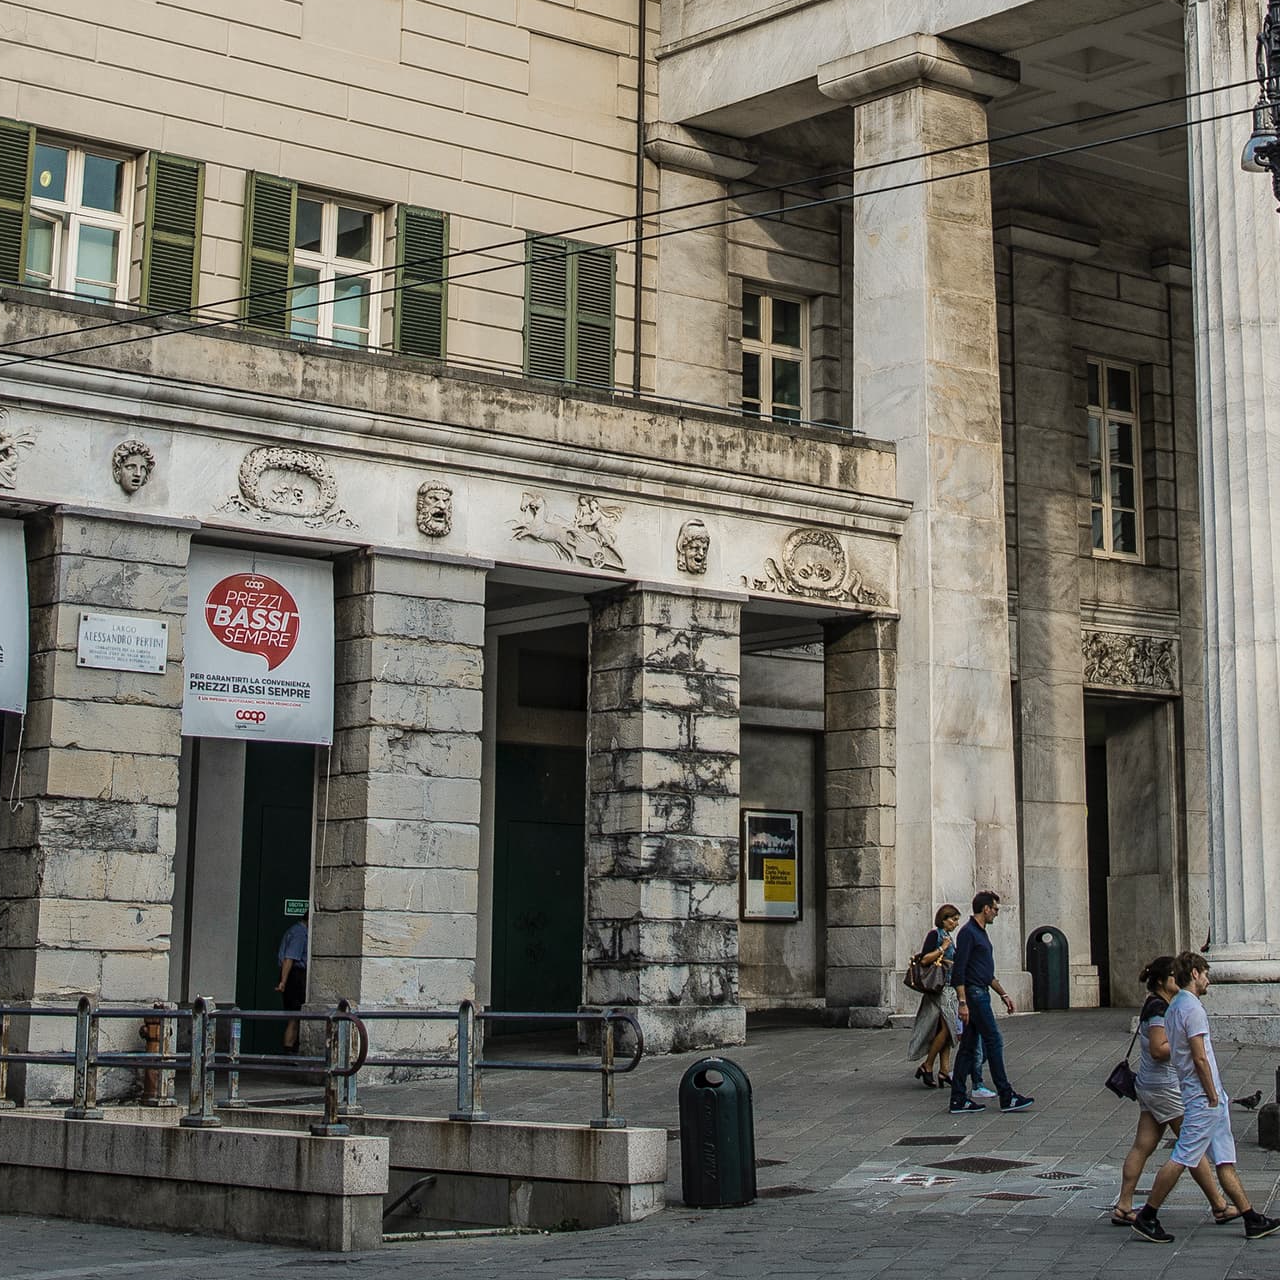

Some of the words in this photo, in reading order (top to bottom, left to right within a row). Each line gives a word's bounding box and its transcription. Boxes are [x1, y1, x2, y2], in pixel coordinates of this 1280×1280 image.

[244, 579, 265, 591] coop
[225, 590, 283, 610] PREZZI
[213, 604, 291, 632] BASSI
[84, 631, 132, 646] ALESSANDRO
[135, 636, 164, 649] PERTINI
[223, 627, 291, 648] SEMPRE
[190, 672, 205, 680] PER
[206, 674, 249, 684] GARANTIRTI
[250, 677, 260, 685] LA
[261, 678, 311, 688] CONVENIENZA
[190, 681, 229, 693] PREZZI
[232, 684, 265, 695] BASSI
[268, 687, 311, 699] SEMPRE
[236, 709, 266, 724] coop
